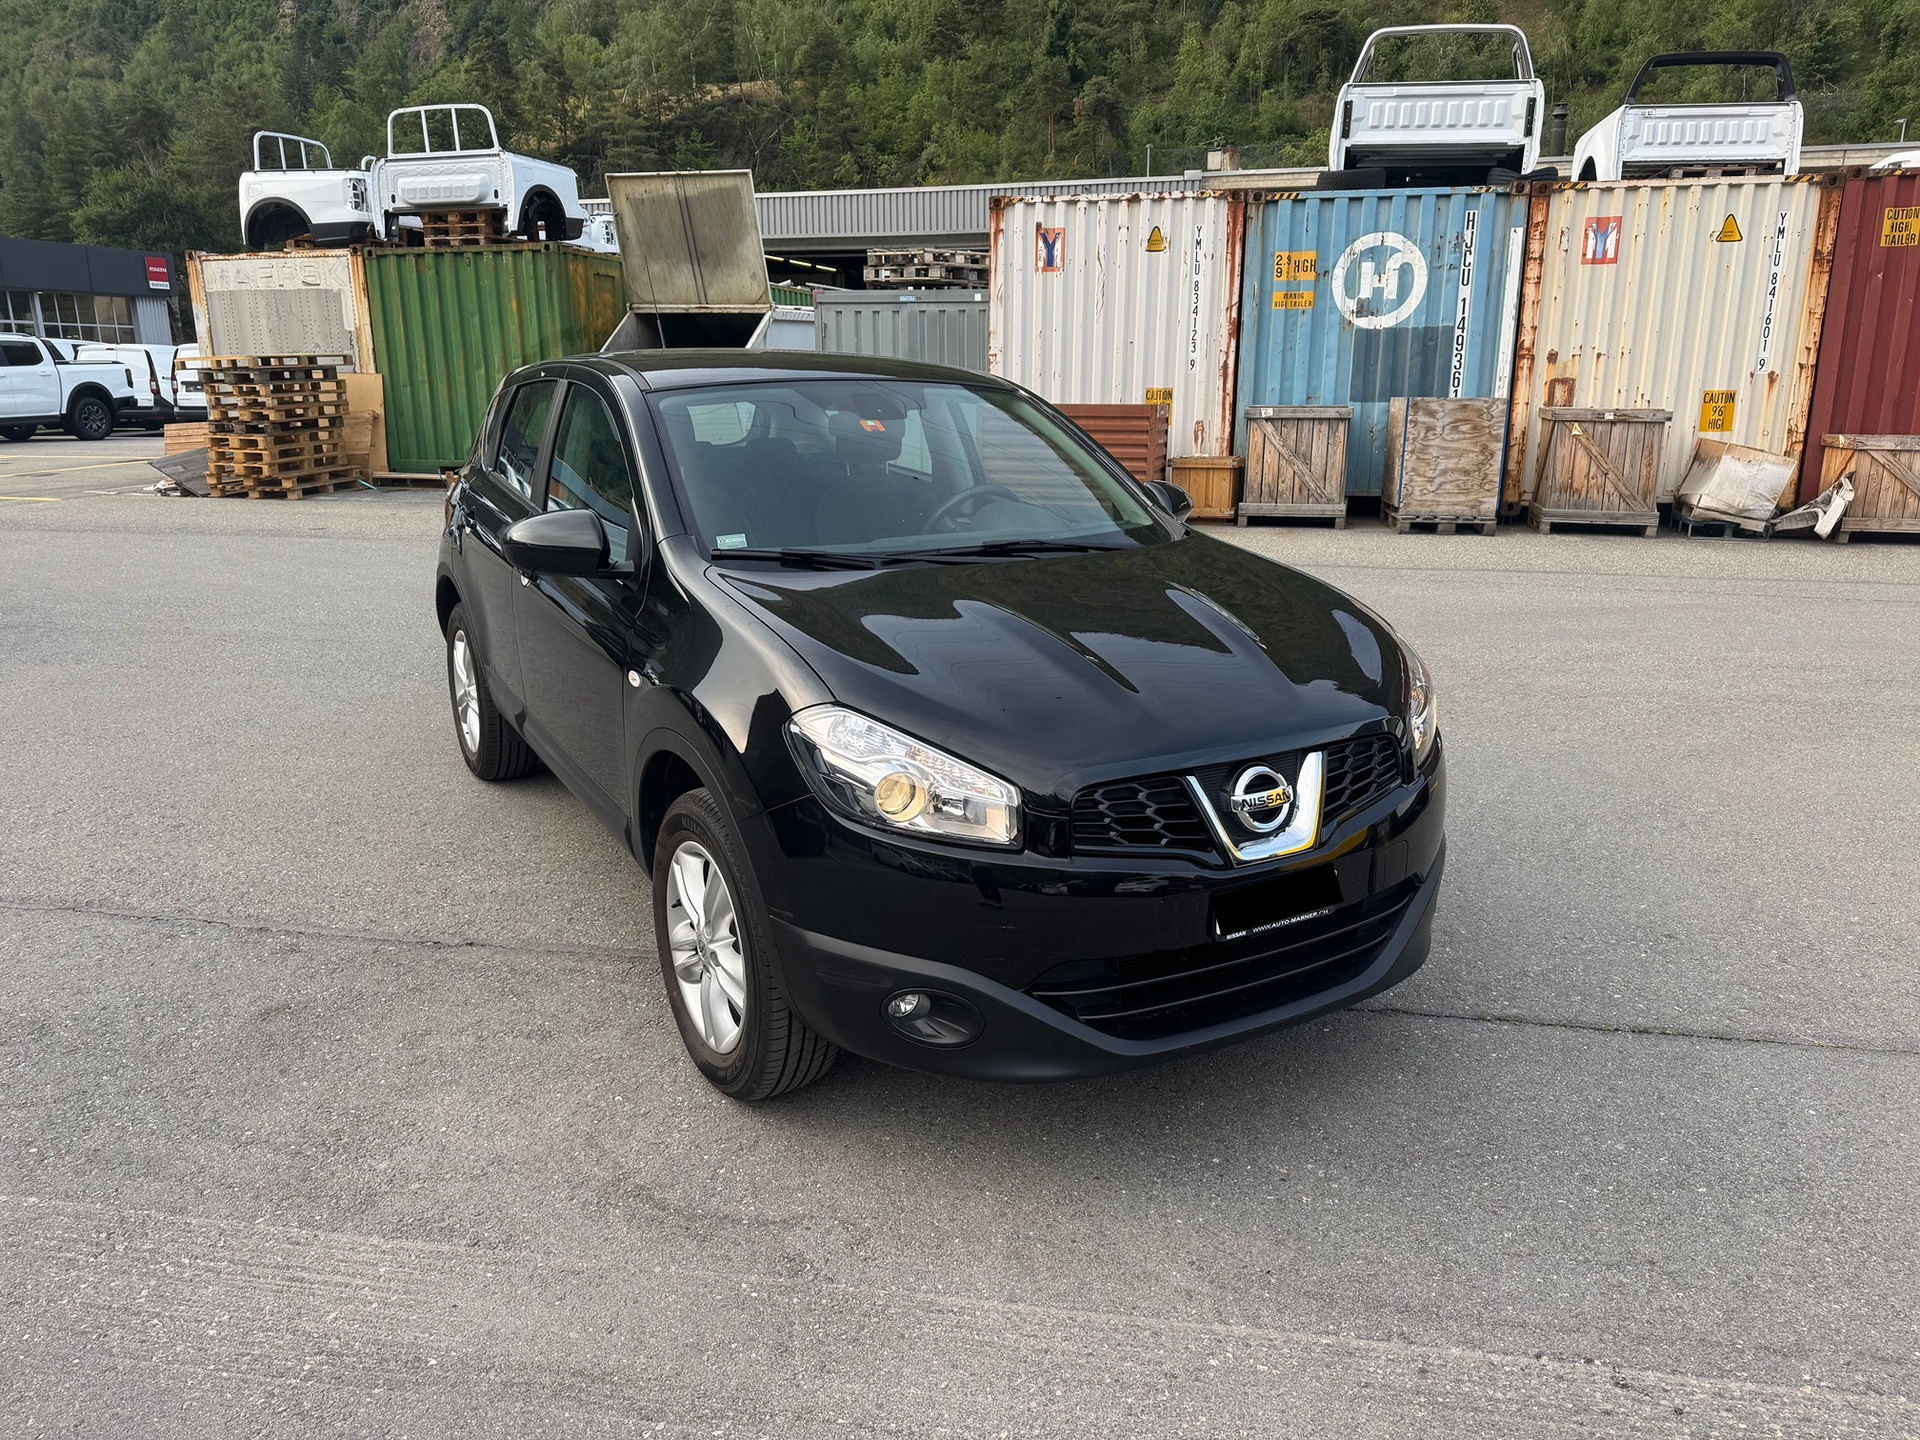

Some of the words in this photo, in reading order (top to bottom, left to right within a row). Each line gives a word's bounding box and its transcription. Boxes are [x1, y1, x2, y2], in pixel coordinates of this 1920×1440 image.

[1194, 225, 1203, 275] YMLU
[1461, 211, 1476, 286] HJCU
[1774, 212, 1787, 266] YMLU
[1190, 280, 1200, 353] 834123
[1762, 272, 1778, 351] 841601
[1189, 359, 1196, 370] 9
[1758, 358, 1766, 371] 9
[1241, 789, 1291, 809] NISSAN
[1226, 930, 1247, 940] NISSAN
